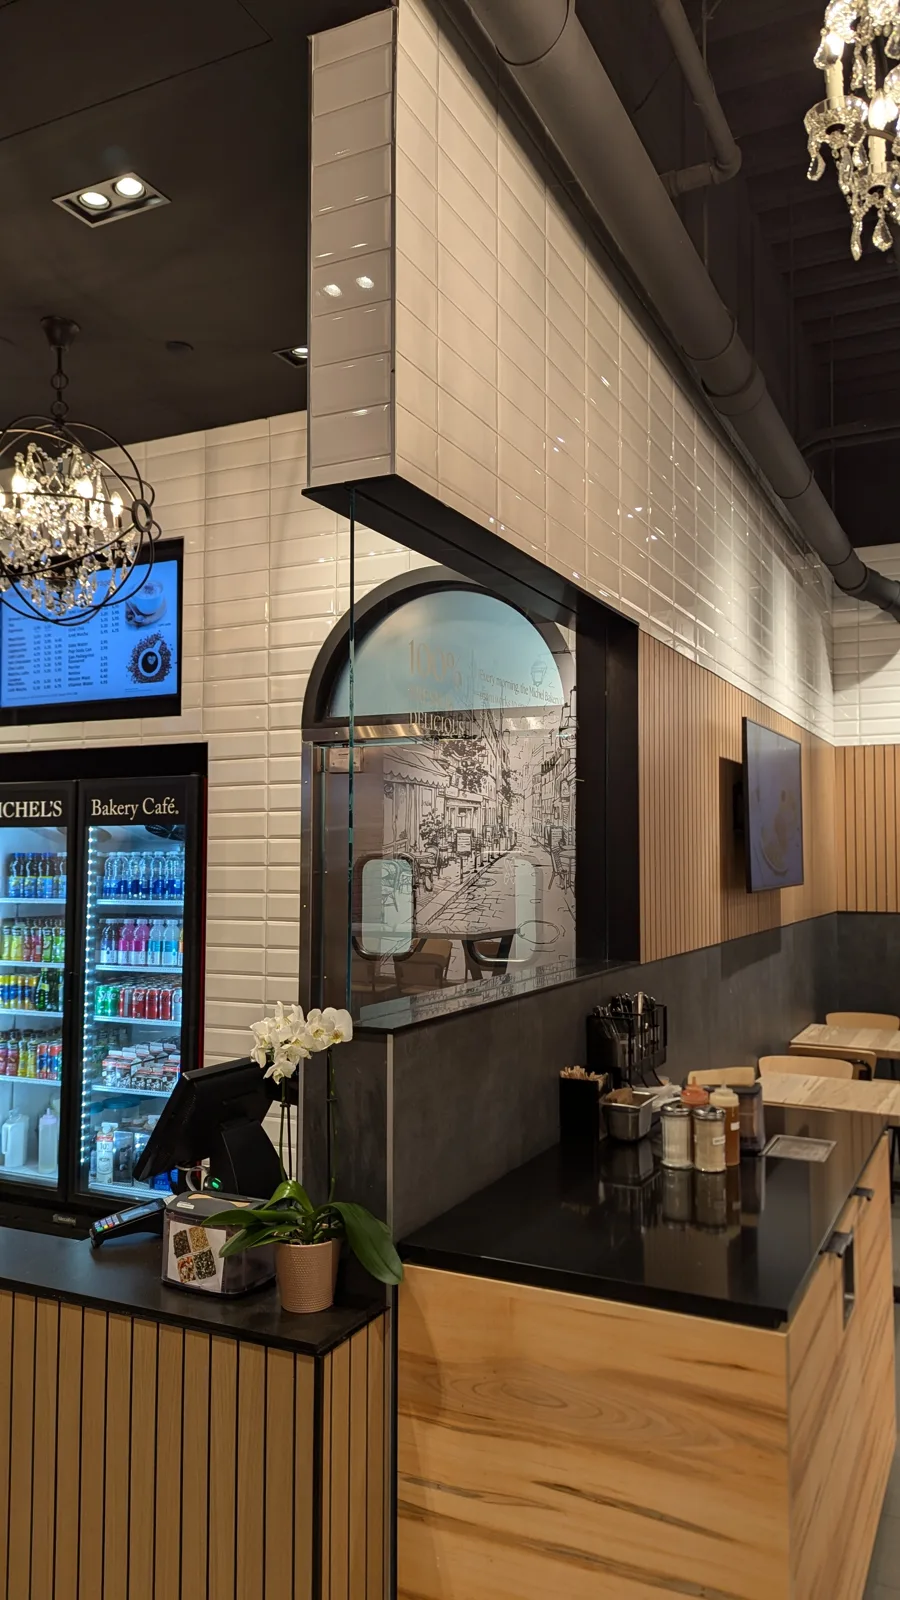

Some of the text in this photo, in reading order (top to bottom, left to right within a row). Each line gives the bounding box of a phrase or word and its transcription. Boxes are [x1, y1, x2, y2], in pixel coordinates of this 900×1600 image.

[408, 639, 463, 690] 100%
[479, 669, 495, 686] Every
[520, 683, 529, 695] the
[409, 711, 465, 738] DELICIOUS
[91, 798, 139, 821] Bakery
[142, 796, 179, 815] Café.
